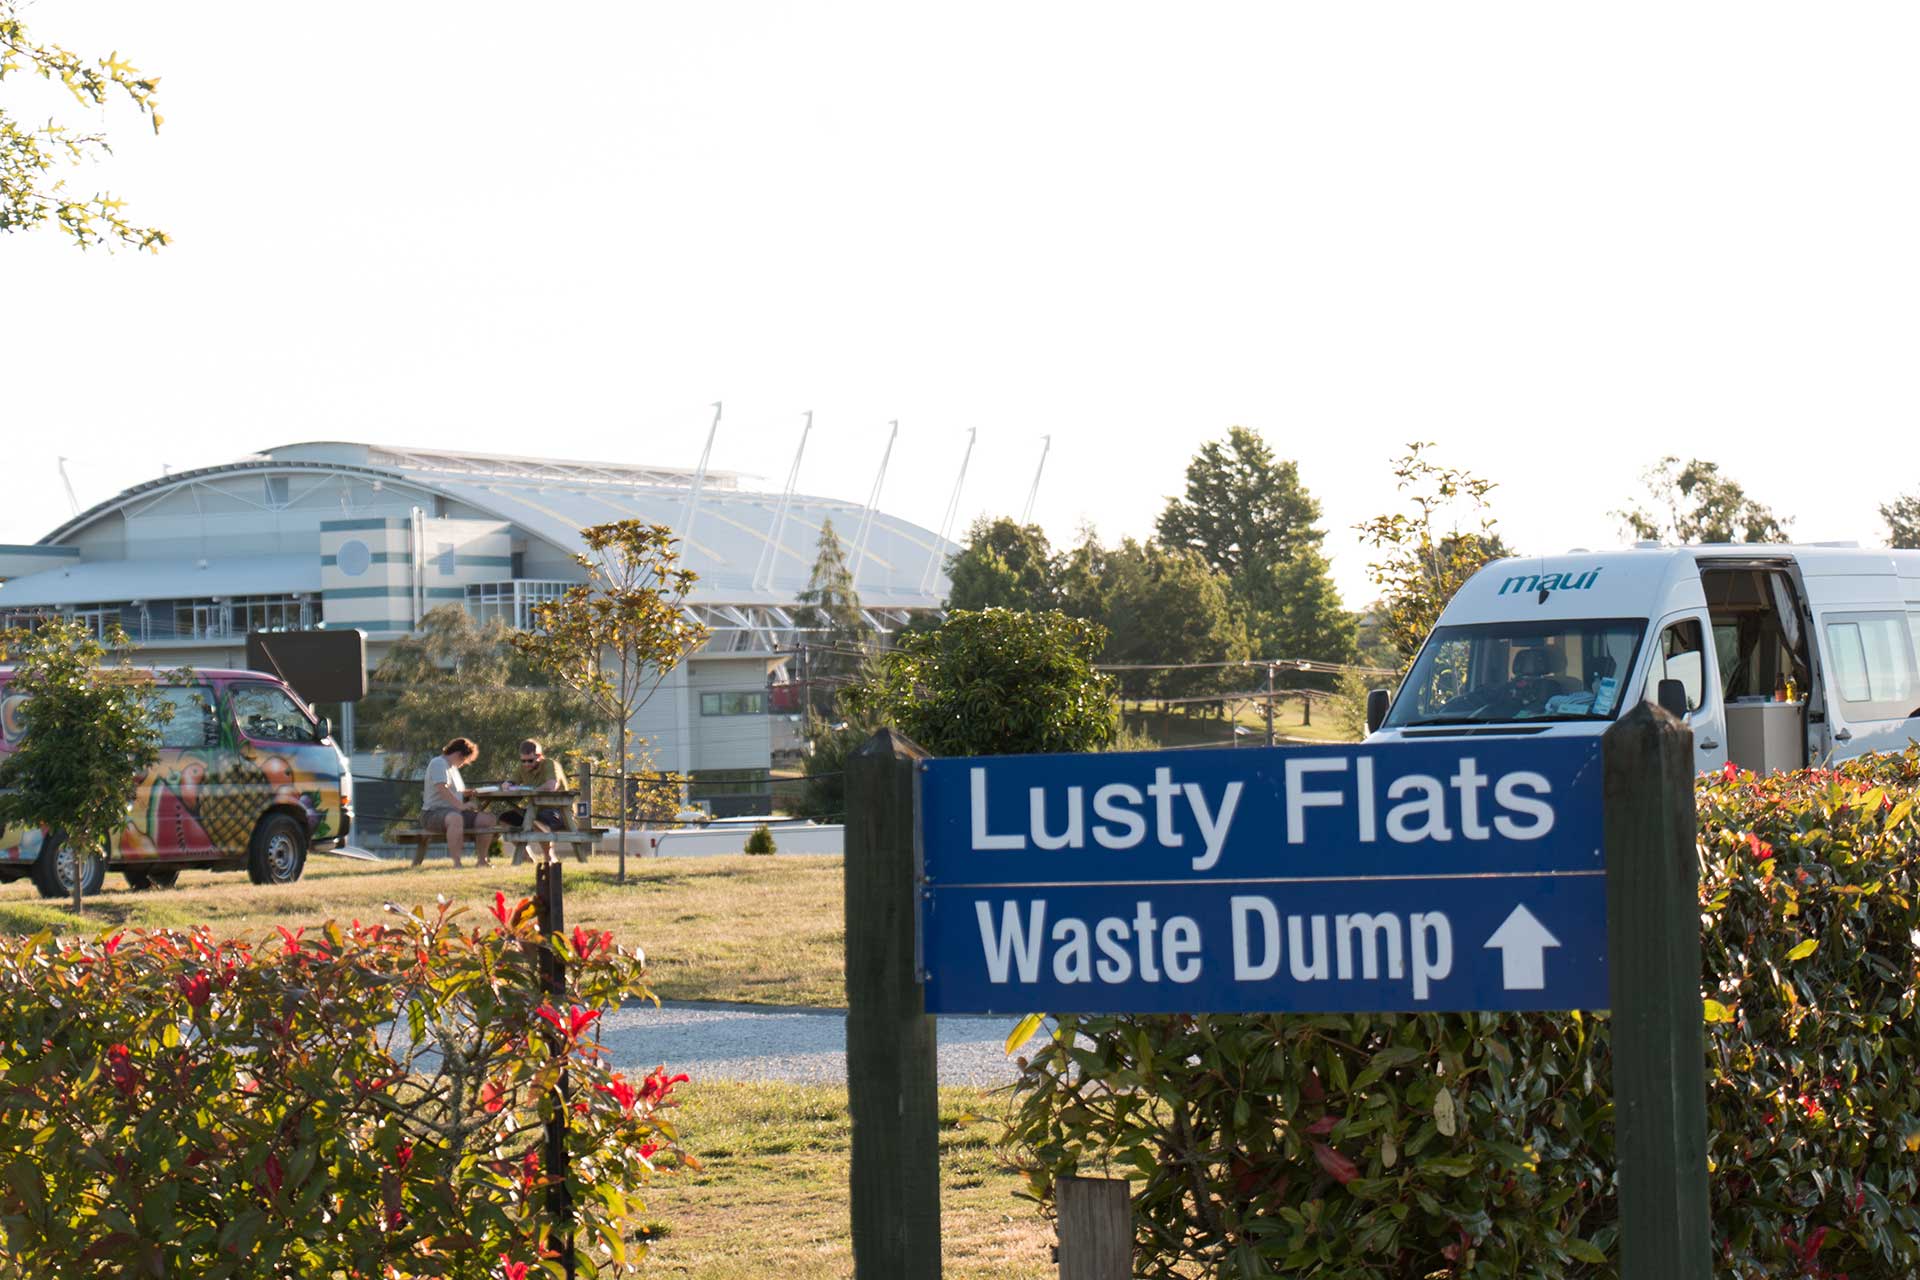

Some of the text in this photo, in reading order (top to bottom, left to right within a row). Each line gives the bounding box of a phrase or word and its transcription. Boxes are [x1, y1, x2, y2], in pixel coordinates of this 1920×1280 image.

[1498, 566, 1603, 596] maui
[970, 756, 1555, 871] Lusty Flats
[975, 896, 1453, 1000] Waste Dump
